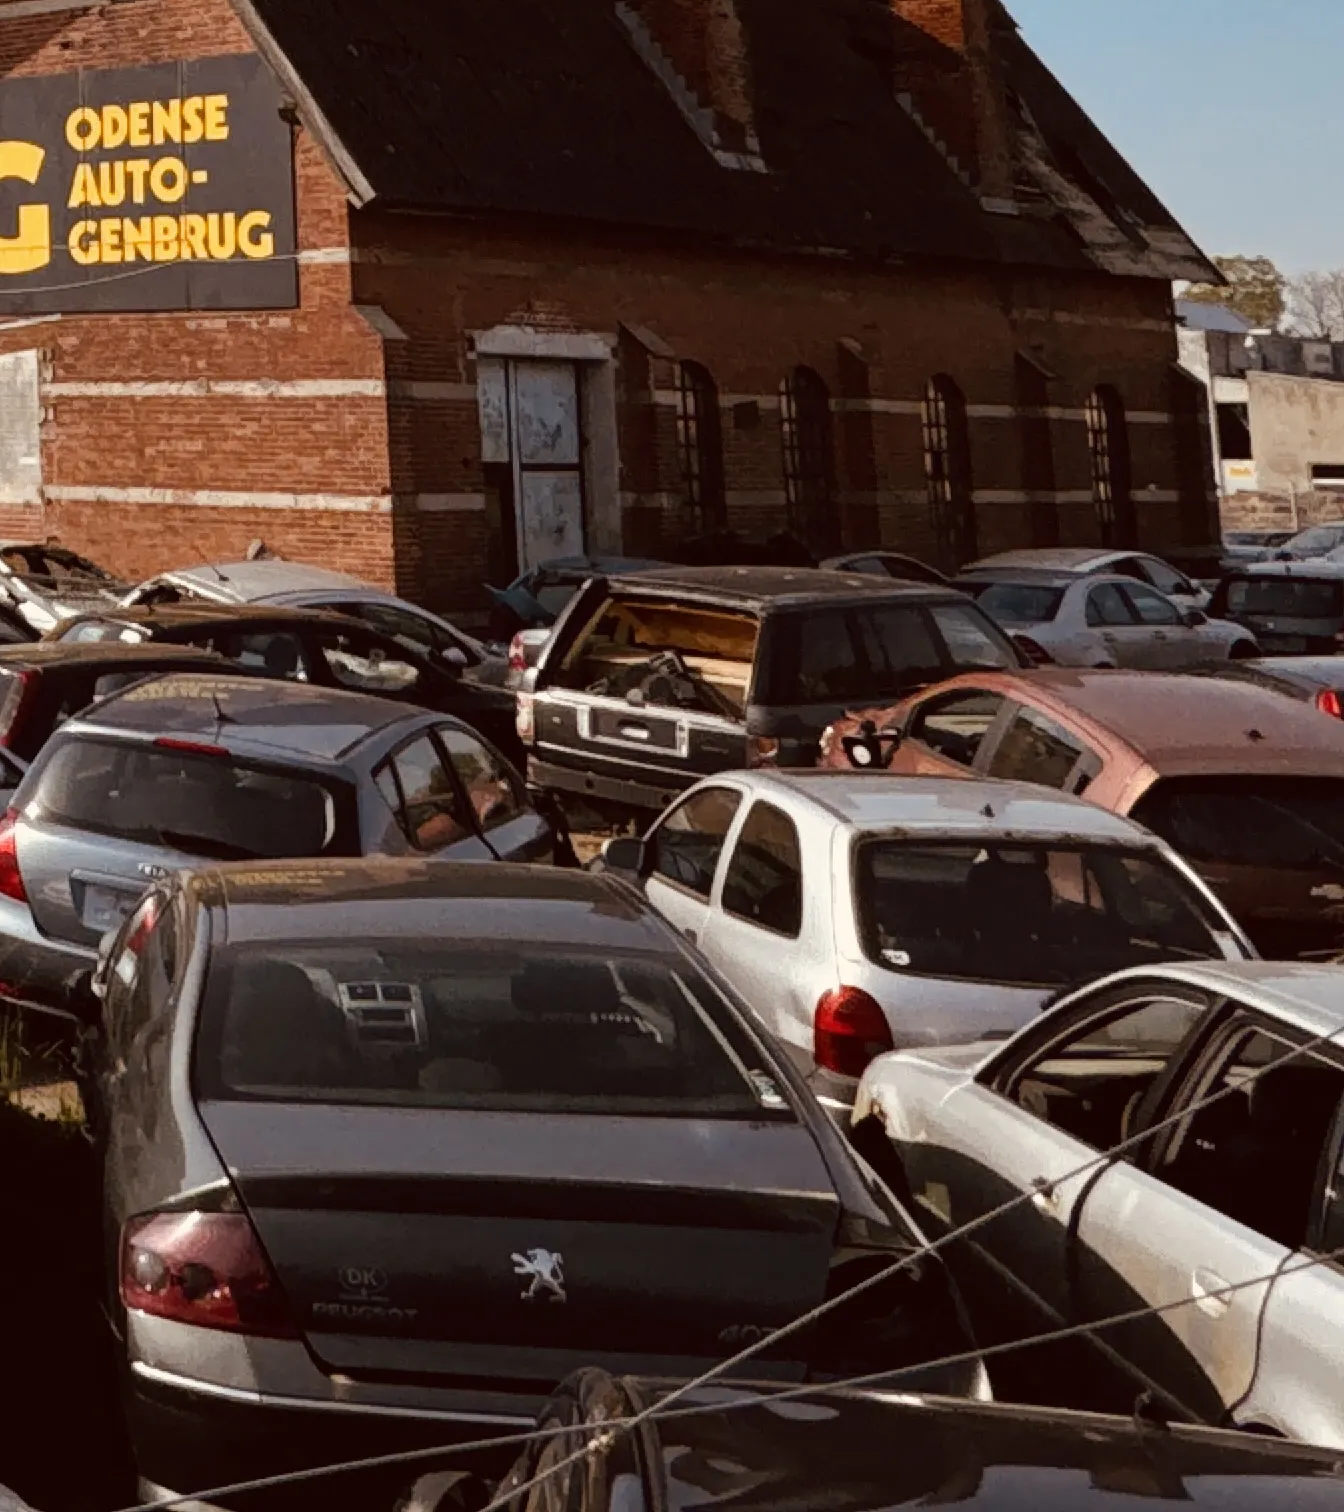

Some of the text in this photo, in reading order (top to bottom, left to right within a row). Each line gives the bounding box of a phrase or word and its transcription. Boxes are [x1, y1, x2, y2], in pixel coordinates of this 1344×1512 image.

[65, 94, 230, 151] ODENSE
[68, 157, 209, 208] AUTO-
[68, 210, 274, 266] GENBRUG
[347, 1268, 378, 1286] DK
